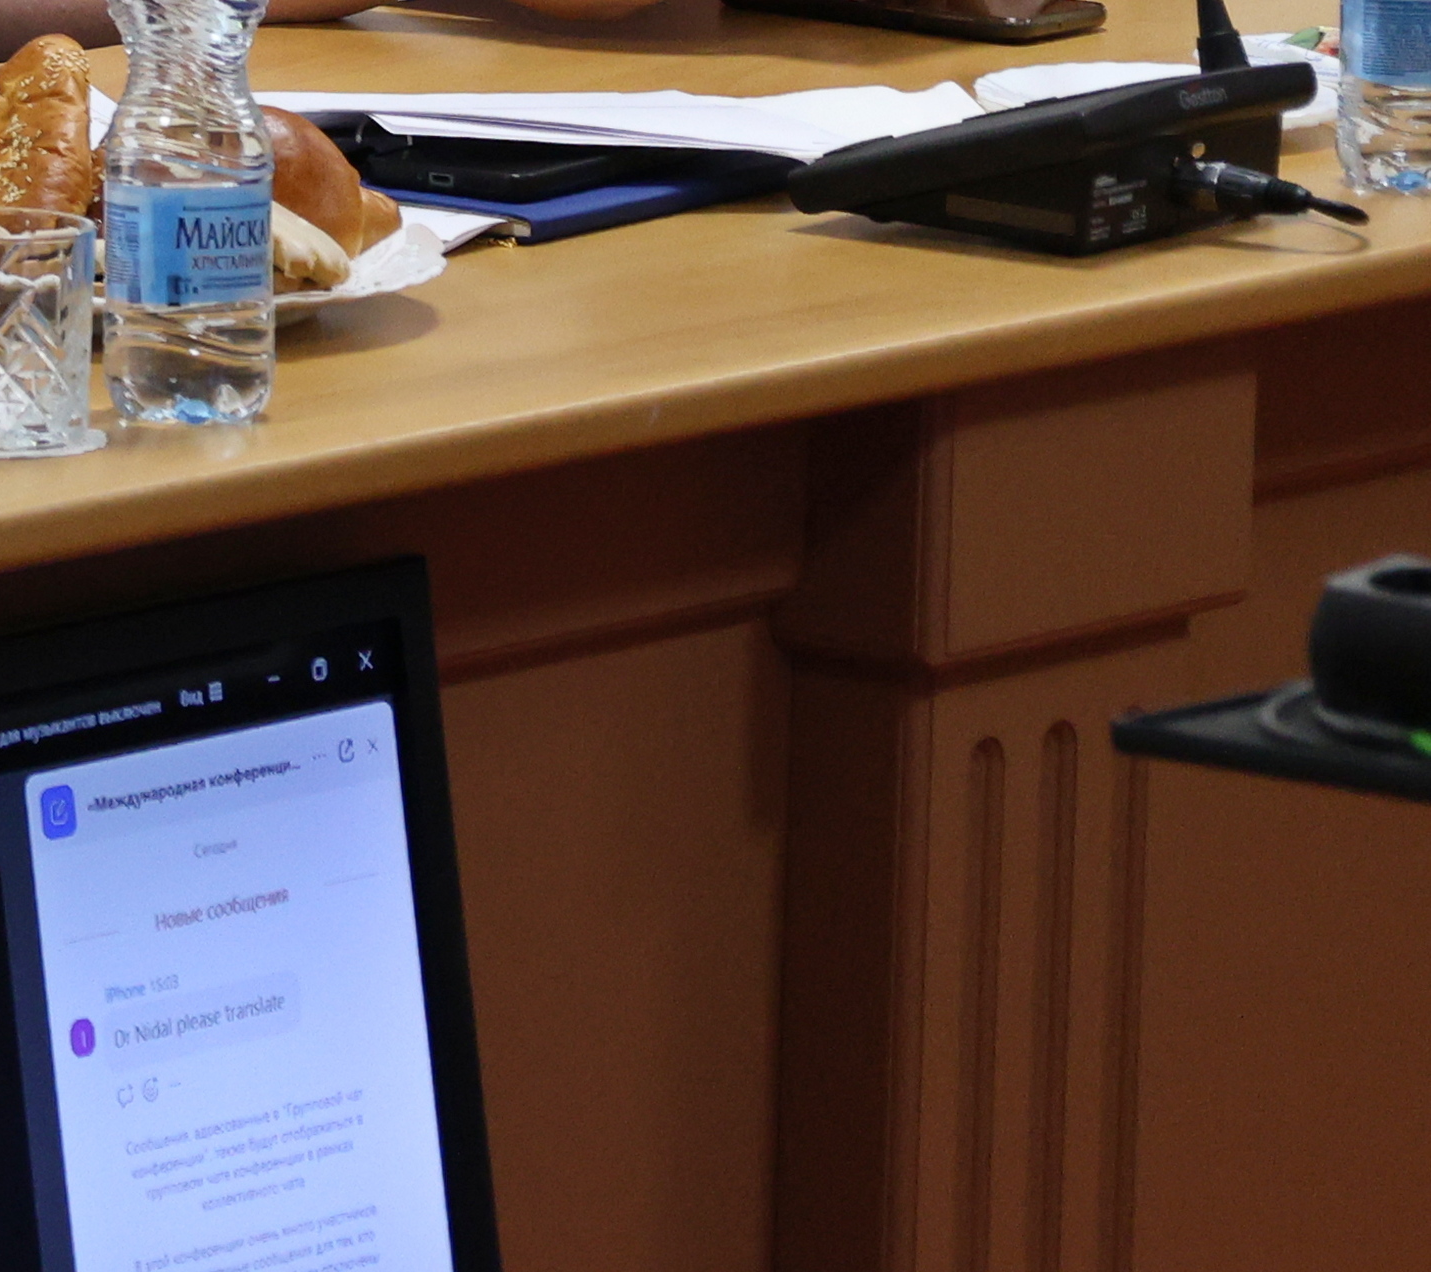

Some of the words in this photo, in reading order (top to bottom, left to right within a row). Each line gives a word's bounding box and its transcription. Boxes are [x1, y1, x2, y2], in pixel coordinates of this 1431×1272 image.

[175, 211, 271, 250] МАЙСКА
[155, 908, 203, 932] Новые
[206, 888, 290, 921] сообщения
[134, 1019, 172, 1044] Nidal
[176, 1010, 221, 1038] please
[224, 995, 286, 1023] translate
